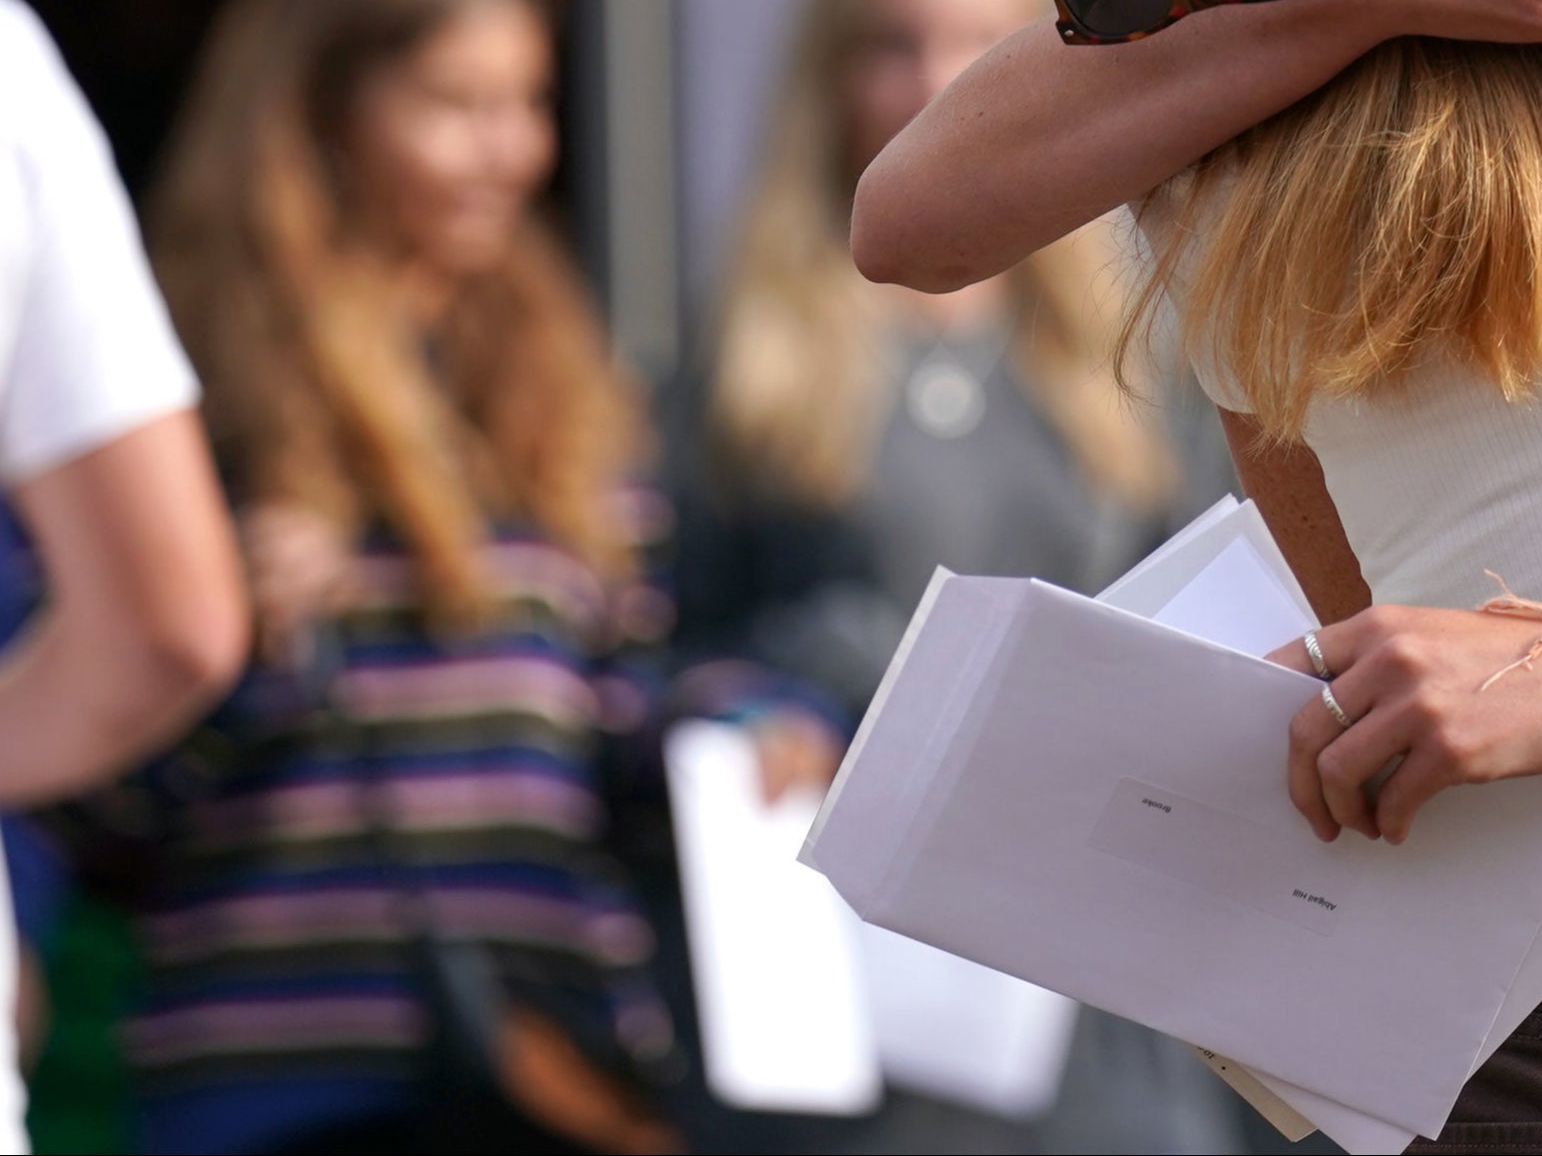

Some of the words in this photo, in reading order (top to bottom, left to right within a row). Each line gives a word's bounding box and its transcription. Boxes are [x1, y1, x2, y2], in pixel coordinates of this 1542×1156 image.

[1141, 797, 1172, 813] Brooke
[1292, 888, 1307, 900] Hill
[1307, 894, 1337, 911] Abigail
